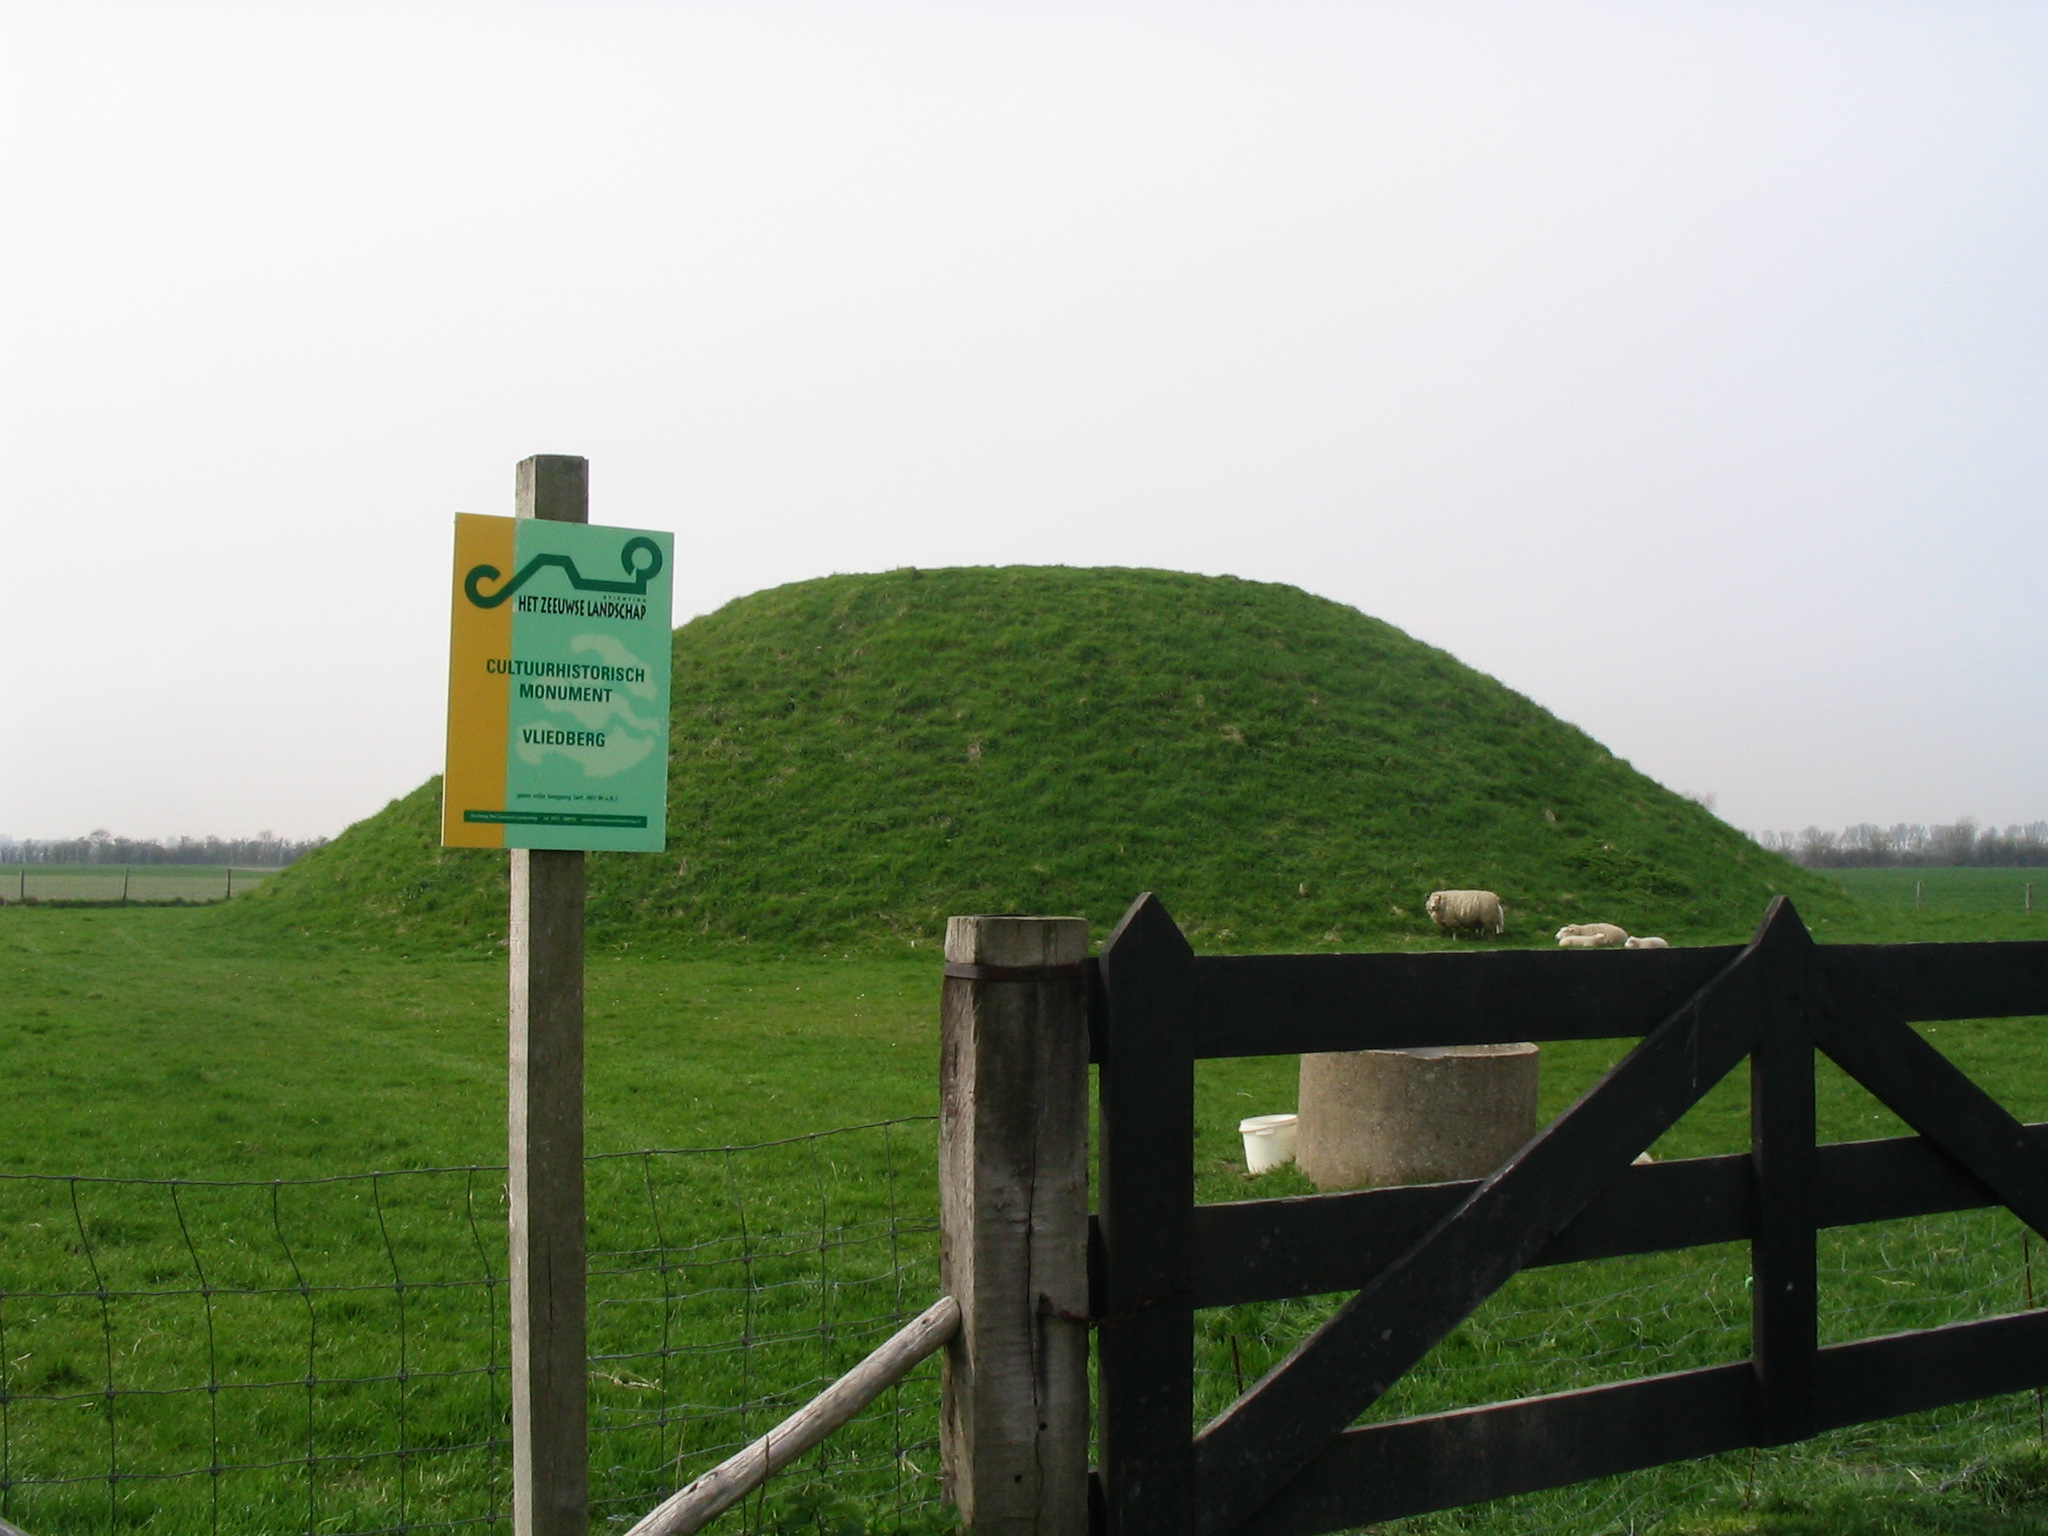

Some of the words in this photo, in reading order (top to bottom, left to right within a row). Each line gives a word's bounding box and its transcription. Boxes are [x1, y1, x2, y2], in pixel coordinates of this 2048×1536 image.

[518, 595, 538, 612] HET
[540, 597, 584, 616] ZEEUWSE
[587, 601, 646, 620] LANDSCHAP
[486, 659, 645, 682] CULTUURHISTORISCH
[519, 684, 612, 703] MONUMENT
[522, 729, 605, 747] VLIEDBERG
